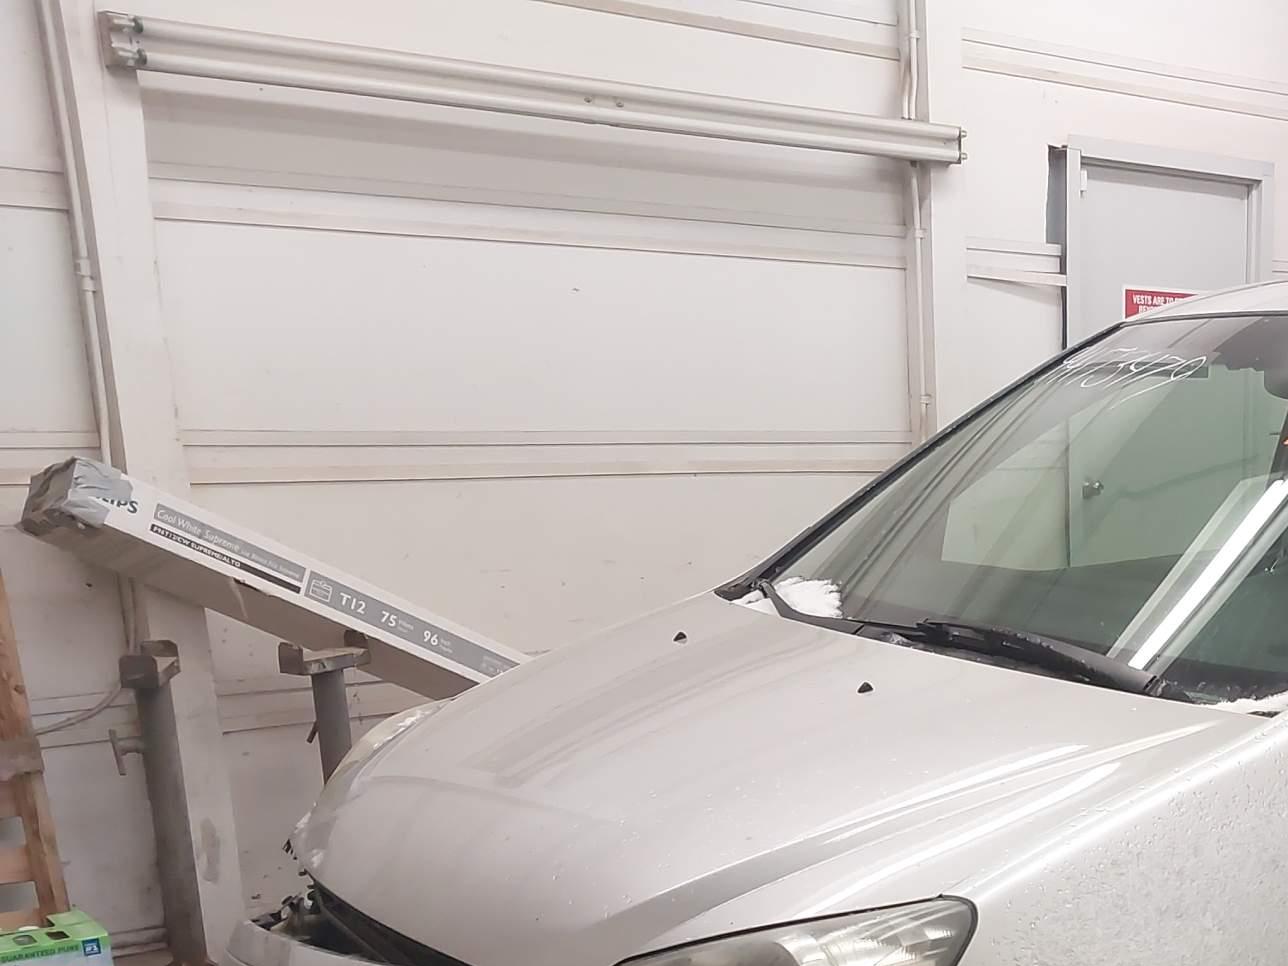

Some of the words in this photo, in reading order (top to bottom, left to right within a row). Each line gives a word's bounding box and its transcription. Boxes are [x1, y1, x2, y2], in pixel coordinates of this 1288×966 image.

[1132, 293, 1152, 305] VESTS
[158, 510, 177, 524] Cool
[178, 518, 201, 535] White
[203, 530, 240, 552] Supreme
[340, 592, 367, 615] T12
[380, 610, 398, 627] 75
[423, 630, 439, 646] 96
